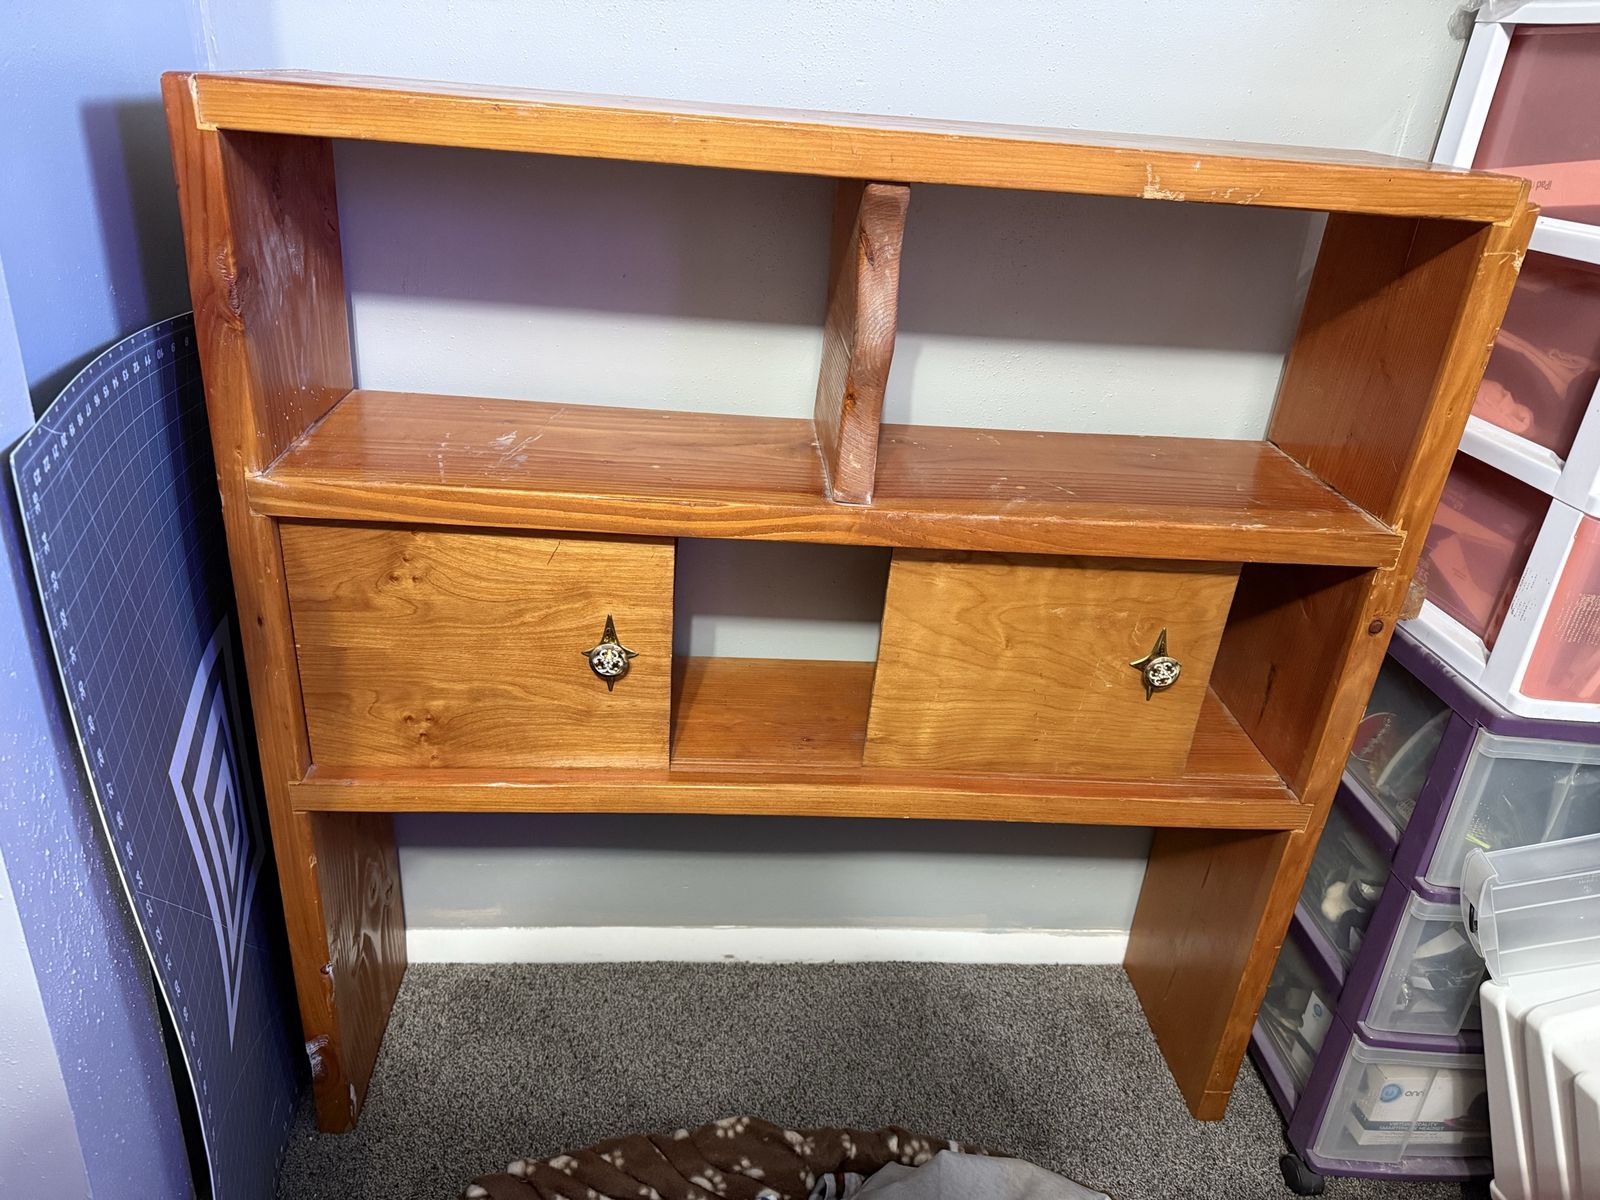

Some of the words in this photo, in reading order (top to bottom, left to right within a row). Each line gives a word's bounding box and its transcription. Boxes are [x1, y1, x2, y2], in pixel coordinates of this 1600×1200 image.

[1536, 180, 1552, 190] iPad
[156, 347, 165, 360] 10
[171, 342, 177, 353] 9
[132, 361, 141, 374] 12
[144, 354, 153, 367] 11
[122, 368, 130, 381] 13
[112, 376, 120, 390] 14
[102, 384, 111, 399] 15
[93, 393, 102, 408] 16
[85, 402, 93, 417] 17
[76, 412, 84, 427] 18
[68, 422, 76, 437] 19
[60, 431, 68, 449] 20
[51, 443, 60, 461] 21
[42, 454, 51, 473] 22
[32, 467, 42, 487] 23
